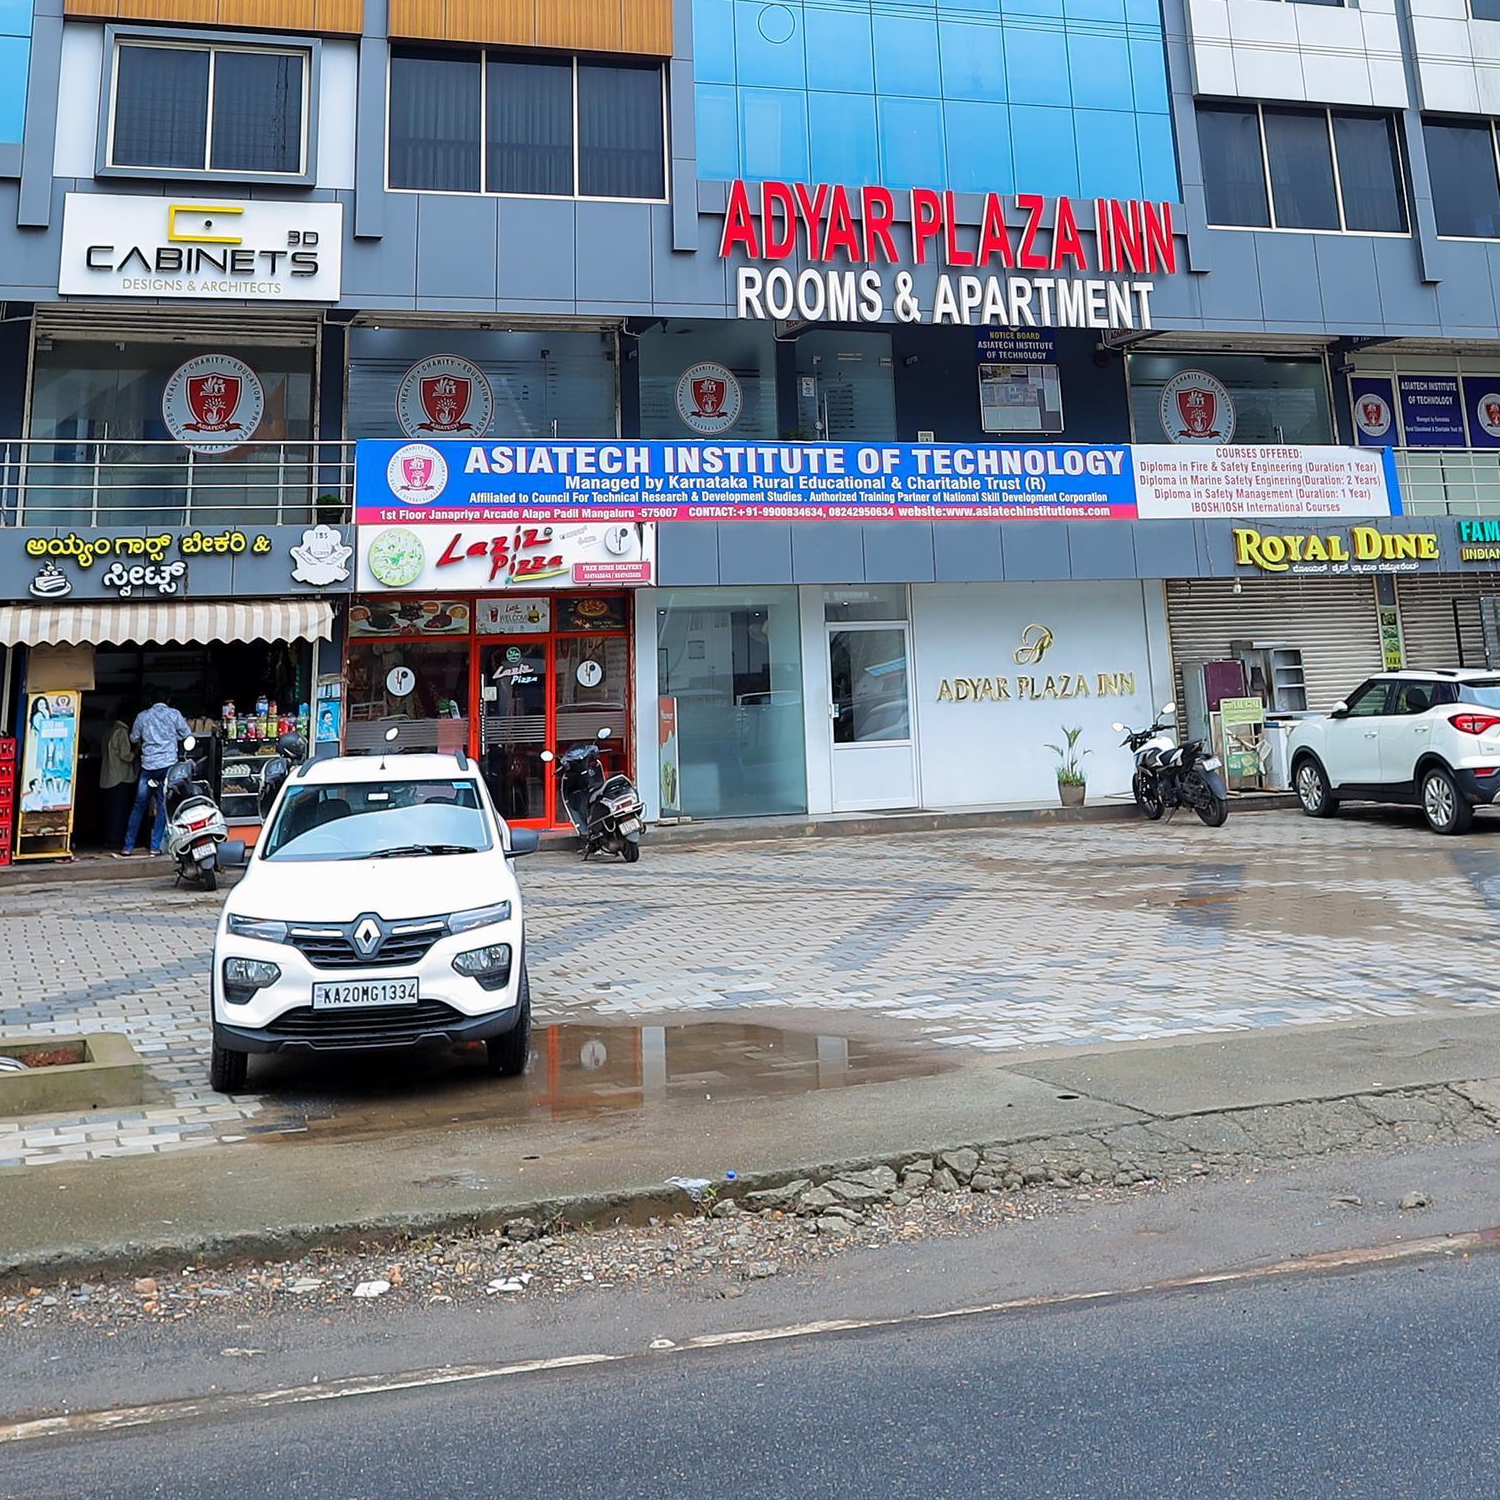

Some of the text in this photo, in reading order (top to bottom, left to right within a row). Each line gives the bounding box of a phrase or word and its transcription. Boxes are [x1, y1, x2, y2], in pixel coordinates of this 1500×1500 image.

[718, 179, 1178, 276] ADYAR PLAZA INN
[287, 231, 319, 246] 3D
[86, 245, 319, 277] CABINETS
[122, 278, 281, 294] DESIGNS & ARCHITECTS
[736, 266, 1154, 330] ROOMS & APARTMENT
[989, 331, 1040, 340] NOTICE BOARD
[978, 341, 1054, 350] ASIATECH INSTITUTE
[188, 357, 226, 370] CHARITY
[987, 351, 1046, 361] OF TECHNOLOGY
[464, 446, 649, 475] ASIATECH
[664, 446, 844, 475] INSTITUTE
[857, 447, 900, 475] OF
[911, 448, 1124, 476] TECHNOLOGY
[1216, 448, 1302, 459] COURSES OFFERED:
[1140, 462, 1377, 474] Diploma in Fire Safety Engineering (Duration Year)
[565, 475, 1046, 492] Managed by Karnataka Rural Educational & Charitable Trust (R)
[1140, 475, 1380, 487] Diploma in Marine Safety Years)
[469, 491, 1108, 504] Affiliated to Council For Technical Research Development Studies Authorized Training Partner National Skill Development Corporation
[1154, 488, 1371, 500] Diploma in Safety Management (Duration: Year)
[380, 509, 397, 520] 1st
[399, 509, 426, 520] Floor
[428, 509, 480, 521] Janapriya
[483, 508, 520, 519] Arcade
[522, 508, 551, 520] Alape
[553, 508, 579, 519] Padil
[581, 508, 635, 520] Mangaluru
[637, 508, 678, 518] -575007
[828, 507, 894, 517] 08242950634
[1246, 502, 1304, 512] International
[1306, 502, 1341, 512] Courses
[181, 531, 246, 553] ಬೇಕರಿ
[253, 534, 272, 553] &
[436, 526, 553, 567] Laziz
[1232, 525, 1440, 572] ROYAL DINE
[489, 555, 564, 582] Pizza
[937, 672, 1135, 702] ADYAR PLAZA INN
[324, 983, 416, 1004] KA20MG1334
